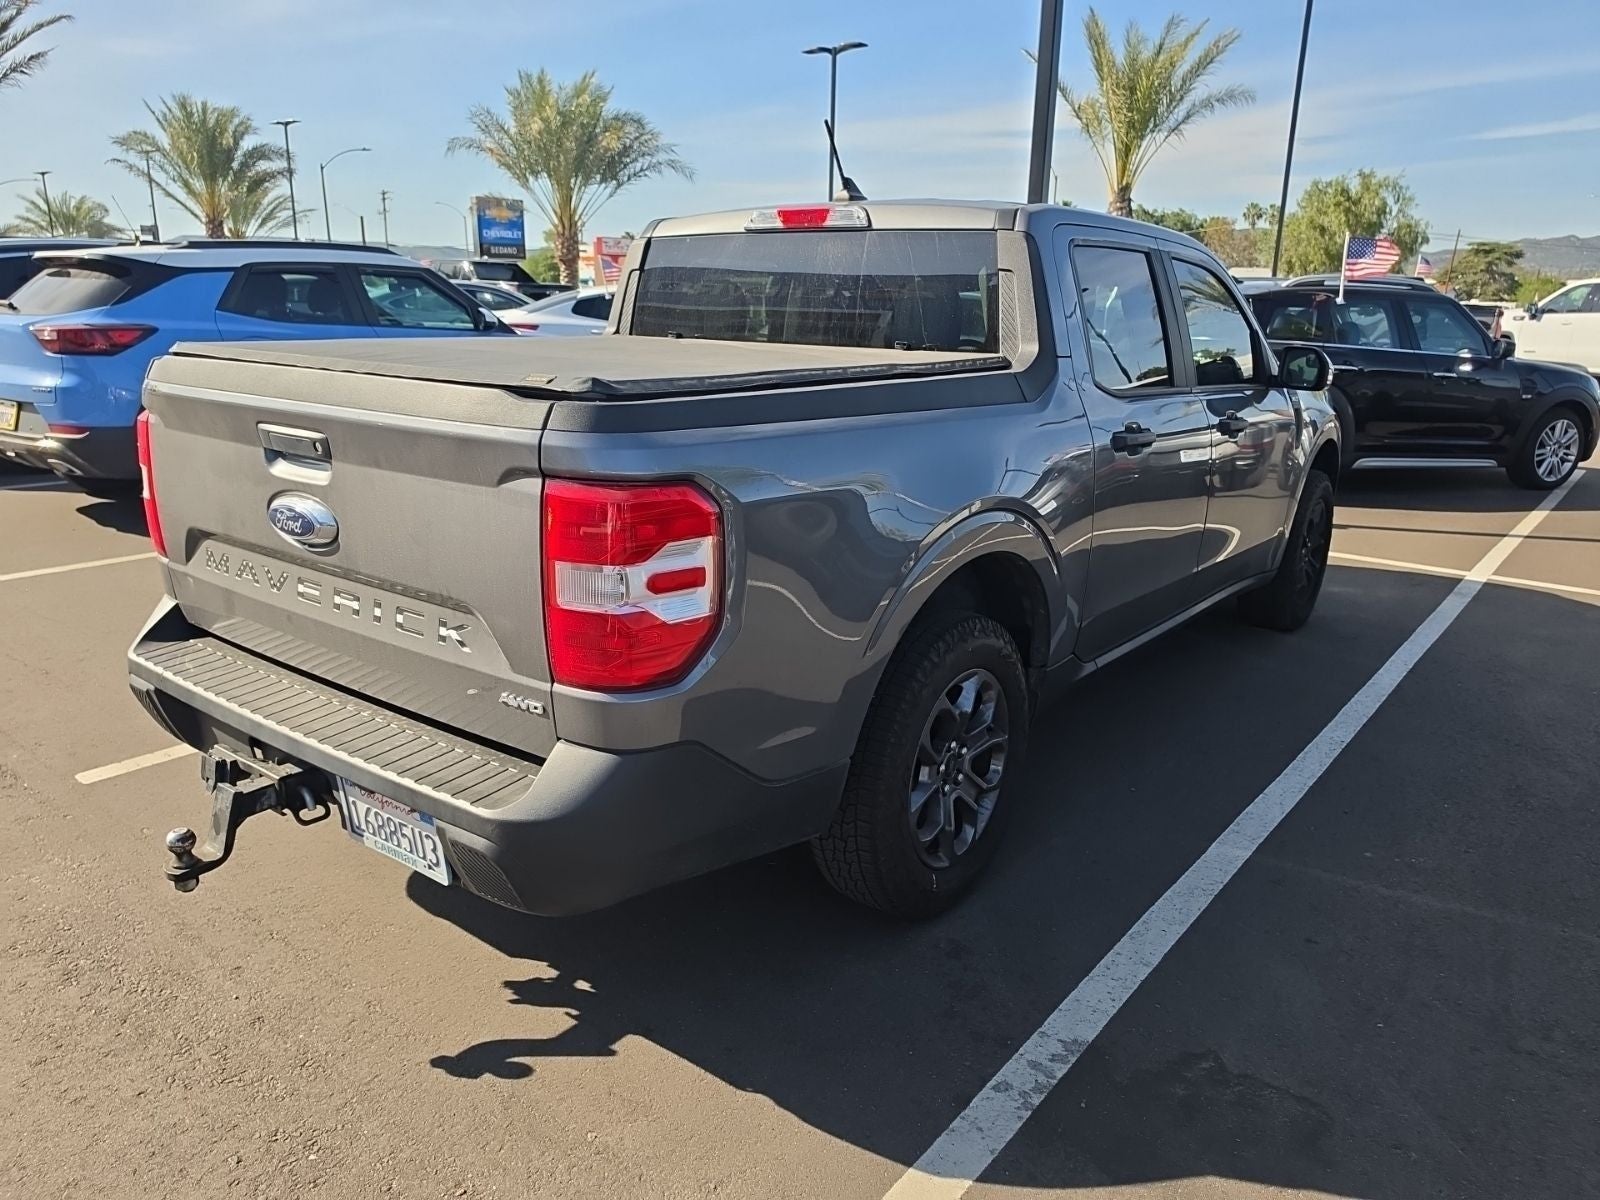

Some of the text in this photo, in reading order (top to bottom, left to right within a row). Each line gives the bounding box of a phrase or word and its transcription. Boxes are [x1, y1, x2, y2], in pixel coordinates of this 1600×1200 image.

[275, 508, 303, 534] Ford
[205, 547, 472, 653] MAVERICK
[498, 691, 545, 715] AWD
[350, 799, 441, 868] 16885U3
